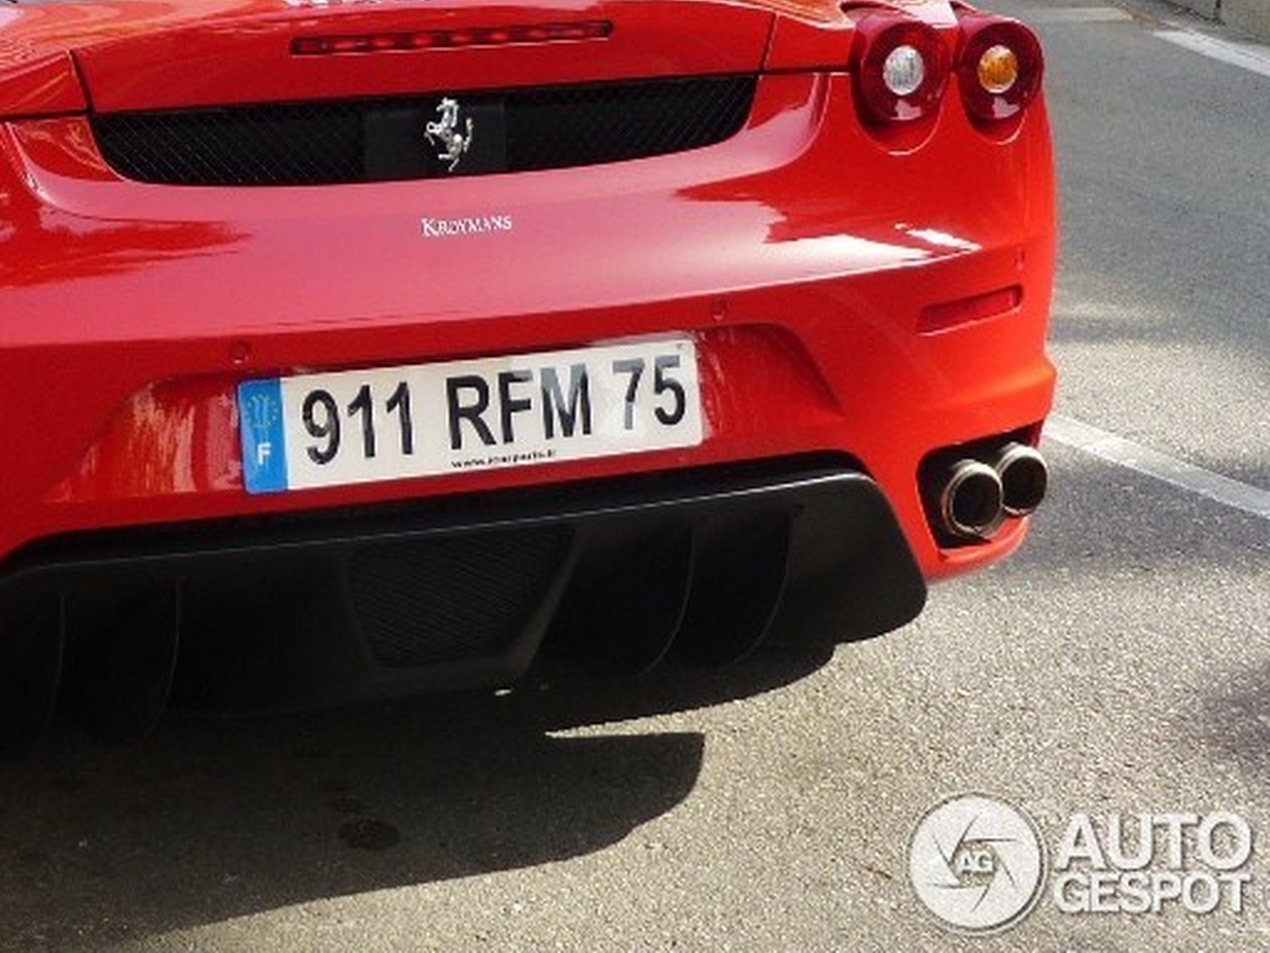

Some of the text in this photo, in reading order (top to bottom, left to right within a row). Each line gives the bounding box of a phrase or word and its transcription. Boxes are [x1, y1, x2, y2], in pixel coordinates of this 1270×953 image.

[302, 355, 686, 465] 911 RFM 75
[257, 442, 272, 465] F
